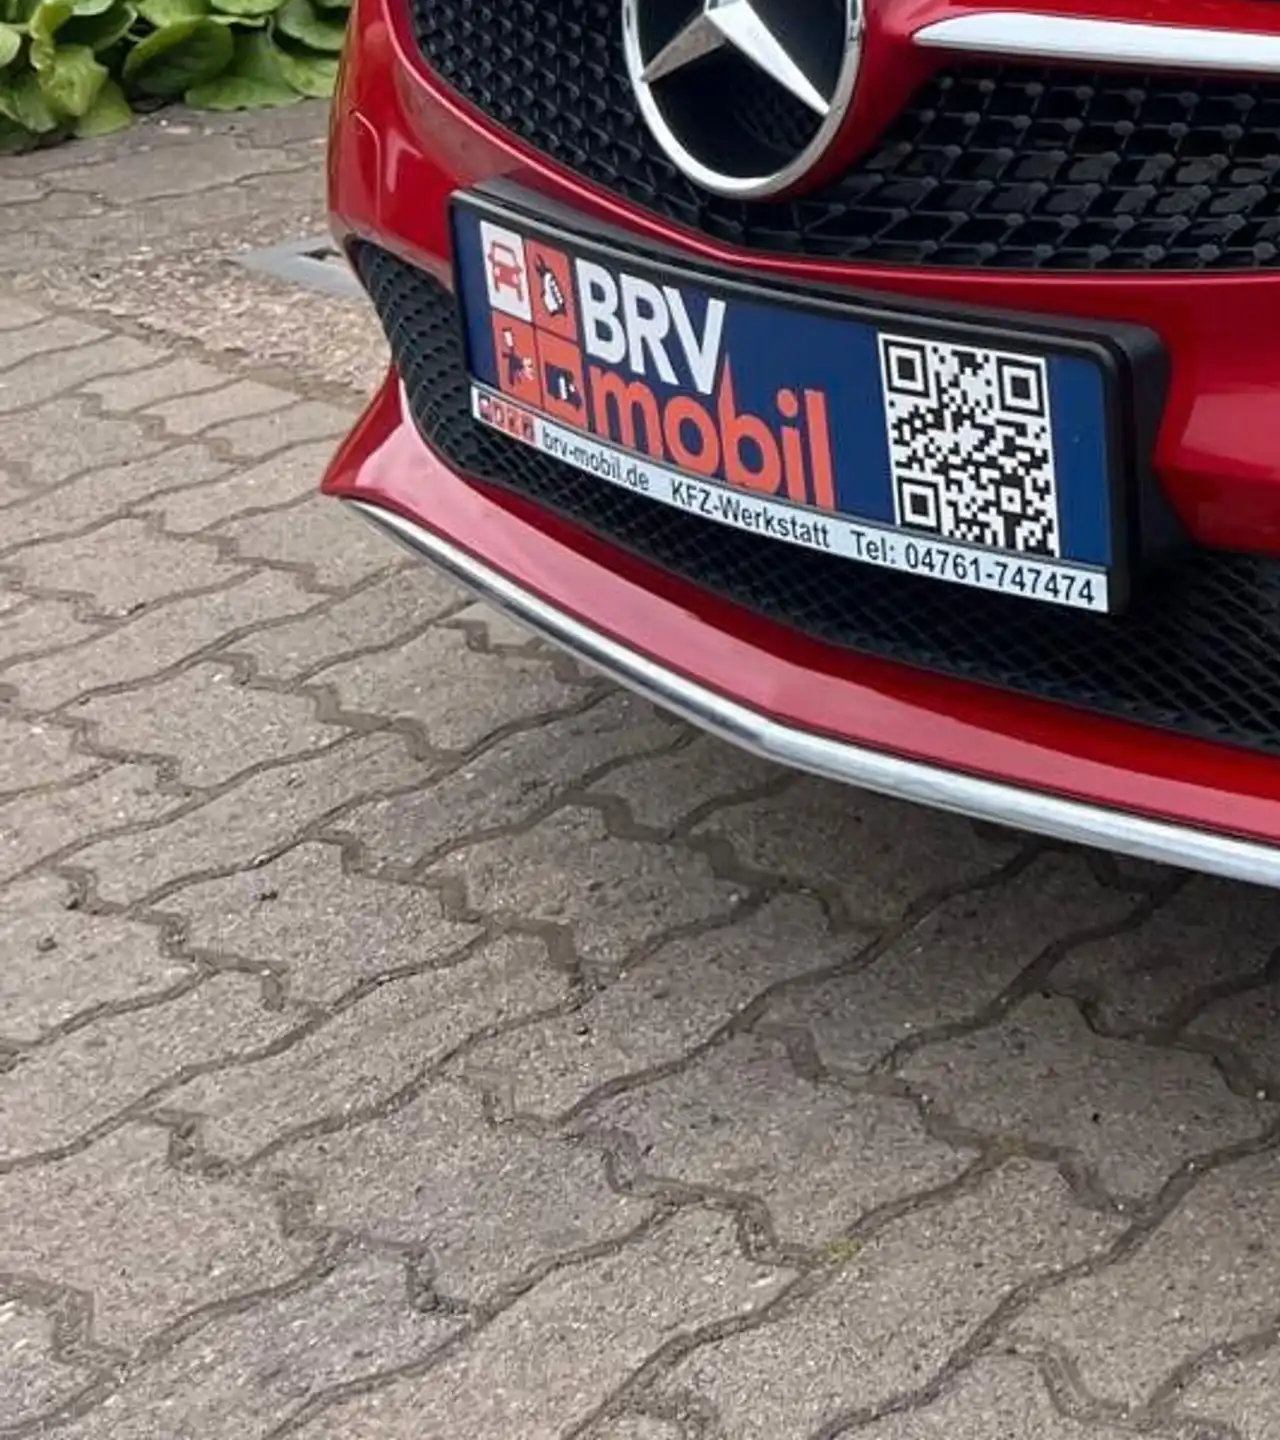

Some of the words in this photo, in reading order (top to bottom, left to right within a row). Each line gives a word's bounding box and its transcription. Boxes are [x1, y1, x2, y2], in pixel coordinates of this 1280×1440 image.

[575, 257, 726, 395] BRV
[588, 353, 836, 513] mobil
[542, 426, 649, 491] brv-mobil.de
[669, 477, 831, 549] KFZ-Werkstatt
[851, 529, 896, 565] Tel:
[904, 542, 1096, 606] 04761-747474
